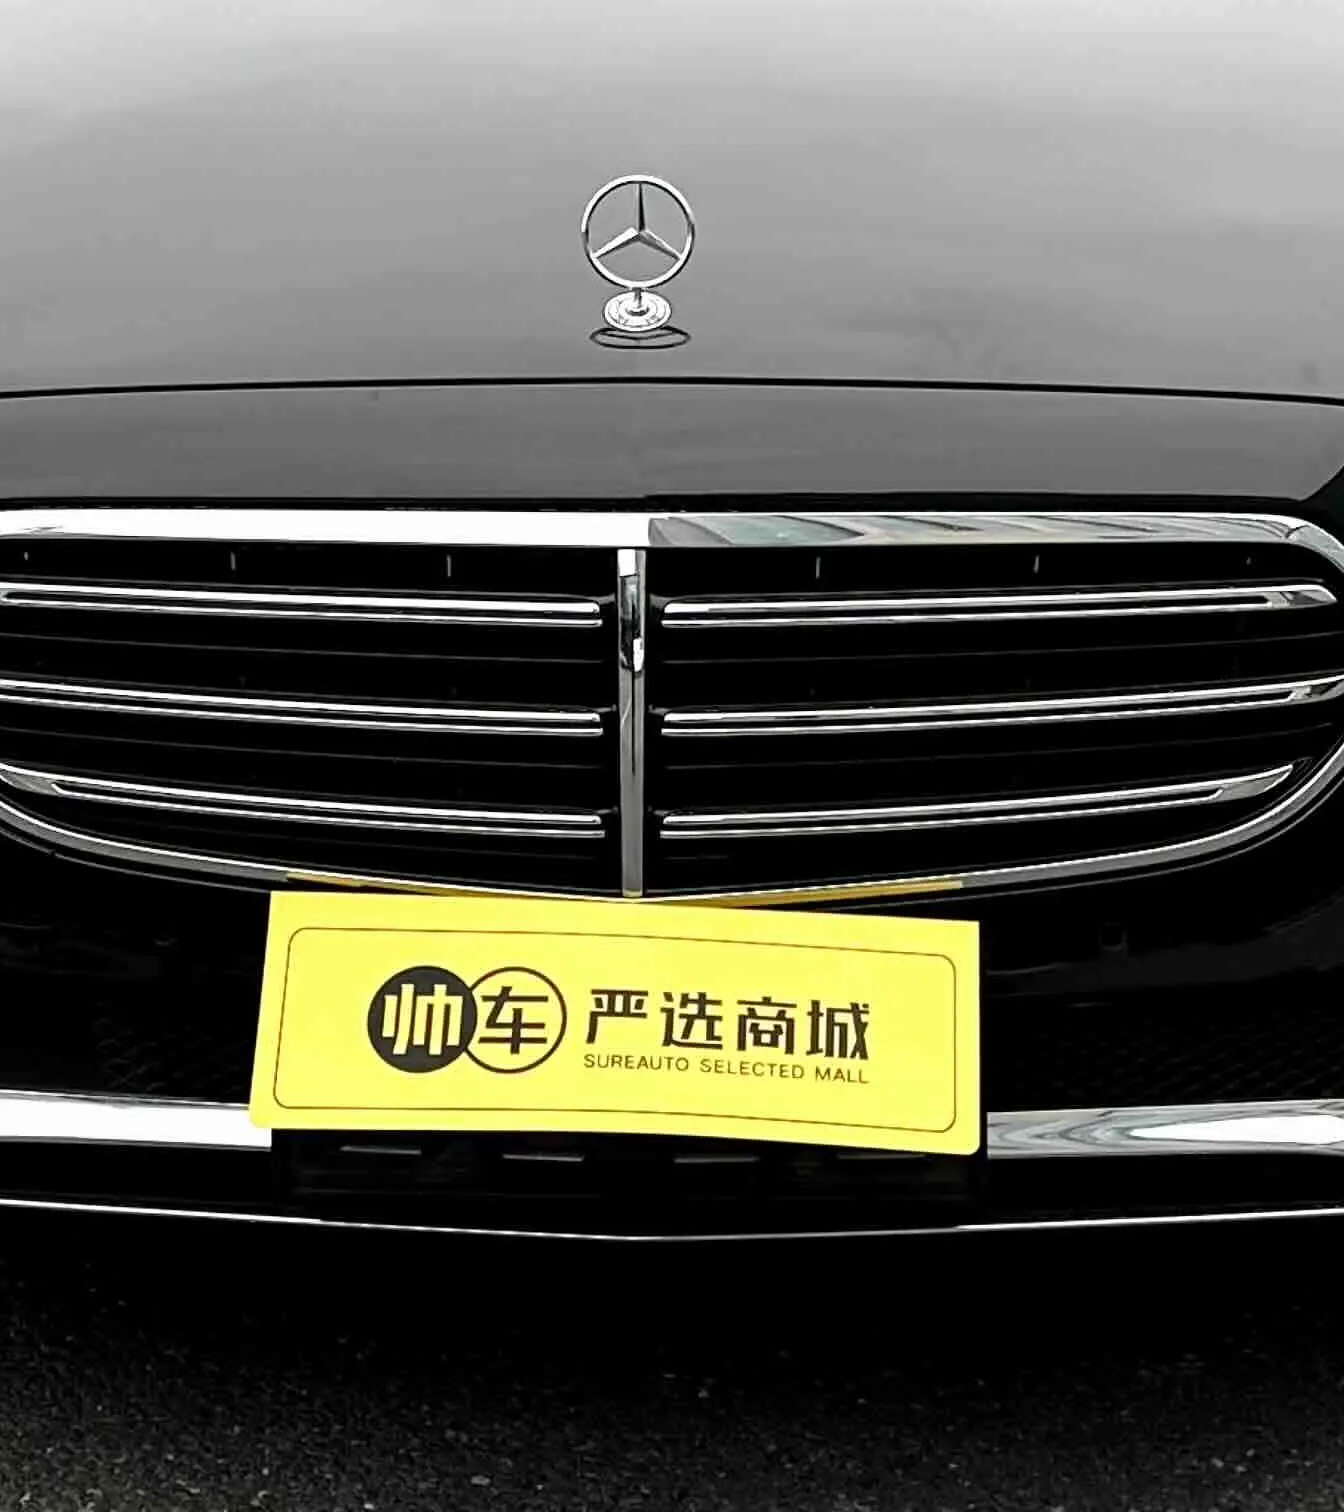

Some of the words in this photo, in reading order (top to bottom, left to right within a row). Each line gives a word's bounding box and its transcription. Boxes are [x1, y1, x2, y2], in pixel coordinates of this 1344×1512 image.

[381, 982, 549, 1056] 帅车
[585, 988, 870, 1060] 严选商城
[583, 1053, 690, 1072] SUREAUTO
[699, 1058, 805, 1080] SELECTED
[814, 1065, 871, 1085] MALL
